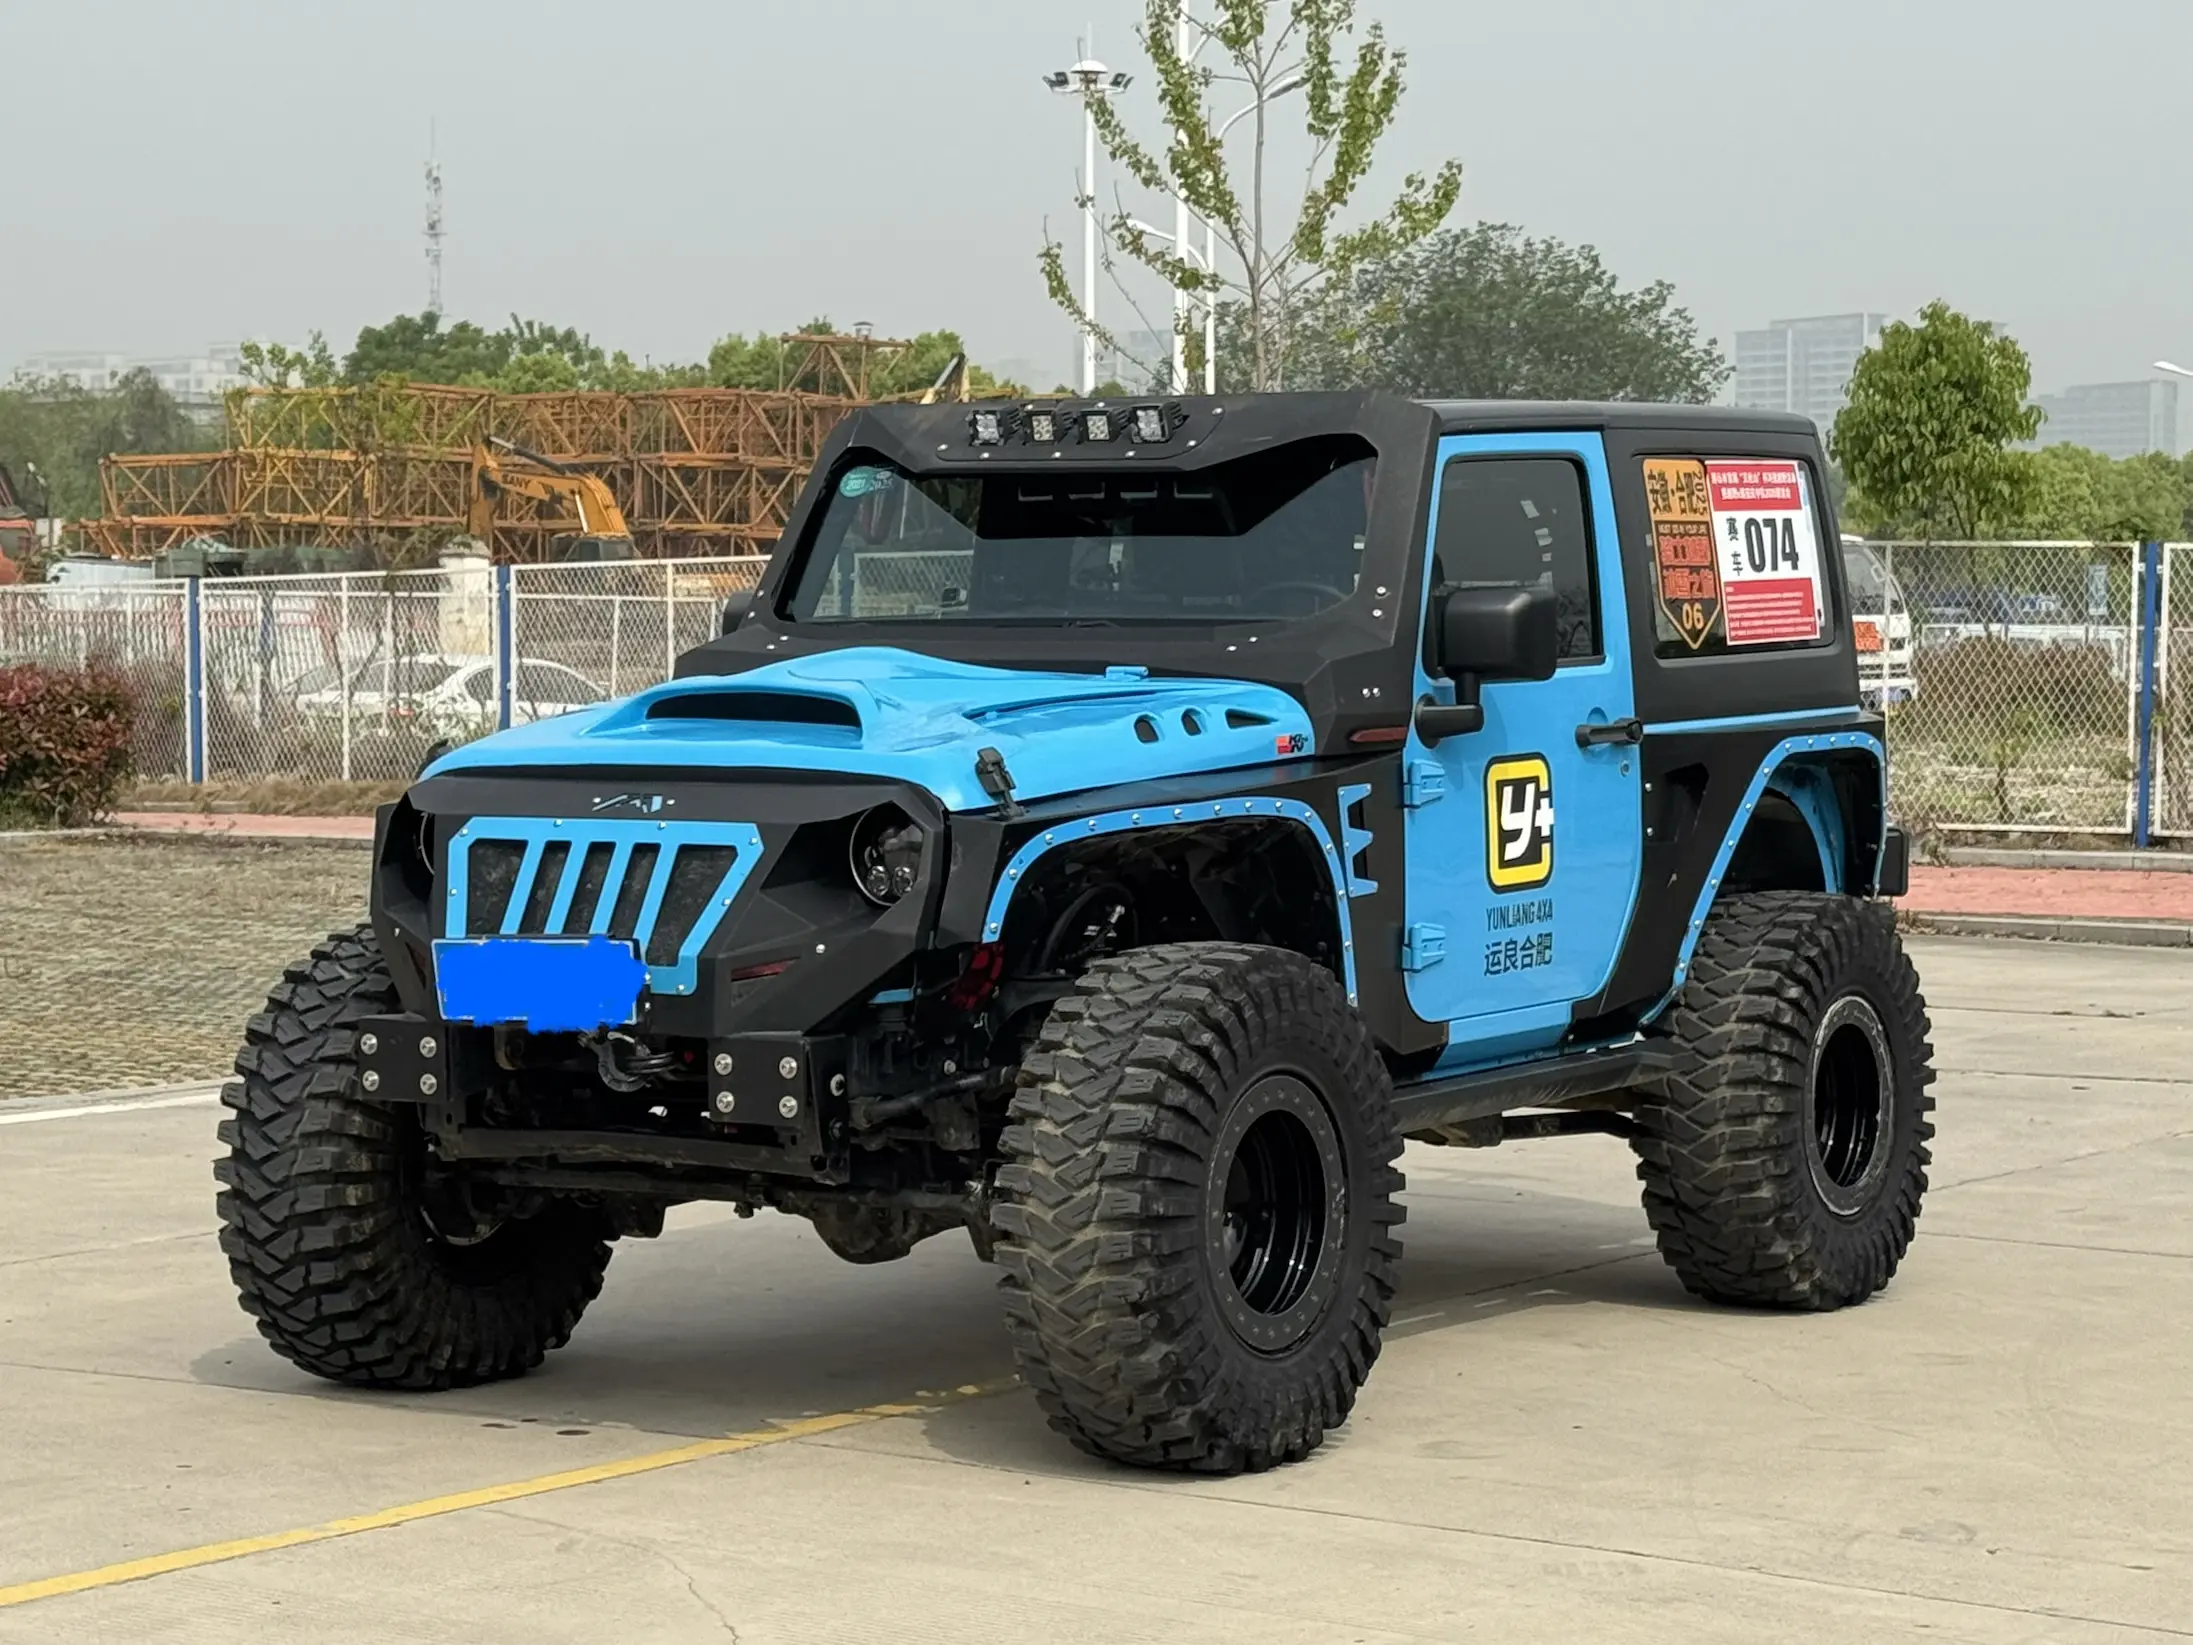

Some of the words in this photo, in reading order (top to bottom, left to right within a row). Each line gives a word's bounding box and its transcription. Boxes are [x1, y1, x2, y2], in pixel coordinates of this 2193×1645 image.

[1692, 468, 1708, 516] 2025
[1744, 516, 1799, 574] 074
[1682, 601, 1705, 631] 06
[1486, 900, 1535, 932] YUNLIANG
[1484, 931, 1553, 977] 运良合肥
